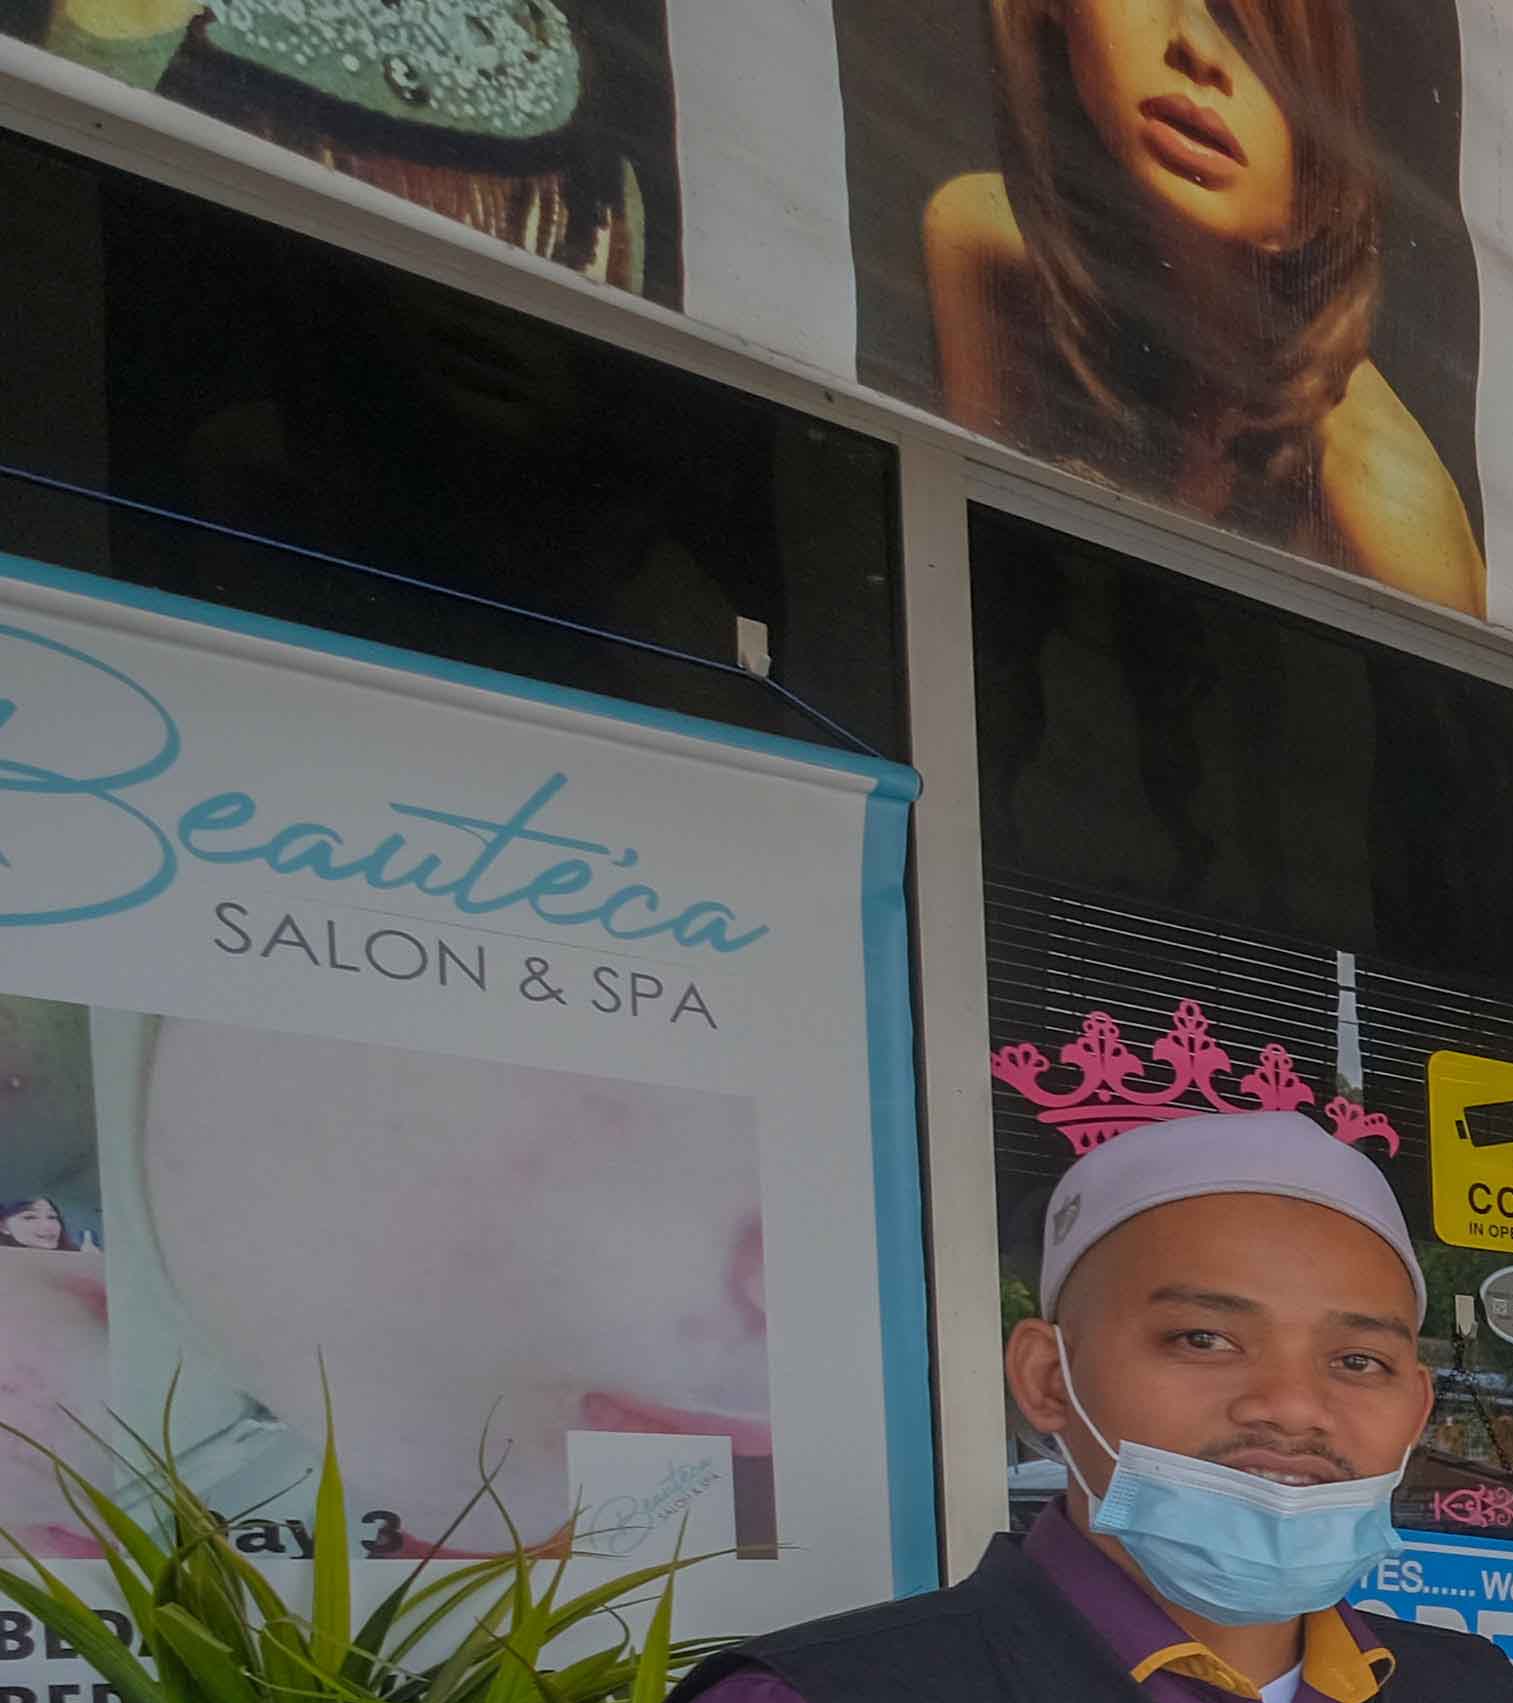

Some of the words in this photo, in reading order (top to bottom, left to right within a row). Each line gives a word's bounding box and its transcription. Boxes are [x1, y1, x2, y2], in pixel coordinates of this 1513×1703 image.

[214, 901, 488, 994] SALON
[519, 955, 567, 1007] &
[591, 966, 718, 1030] SPA
[1469, 1222, 1484, 1236] IN
[361, 1510, 404, 1559] 3
